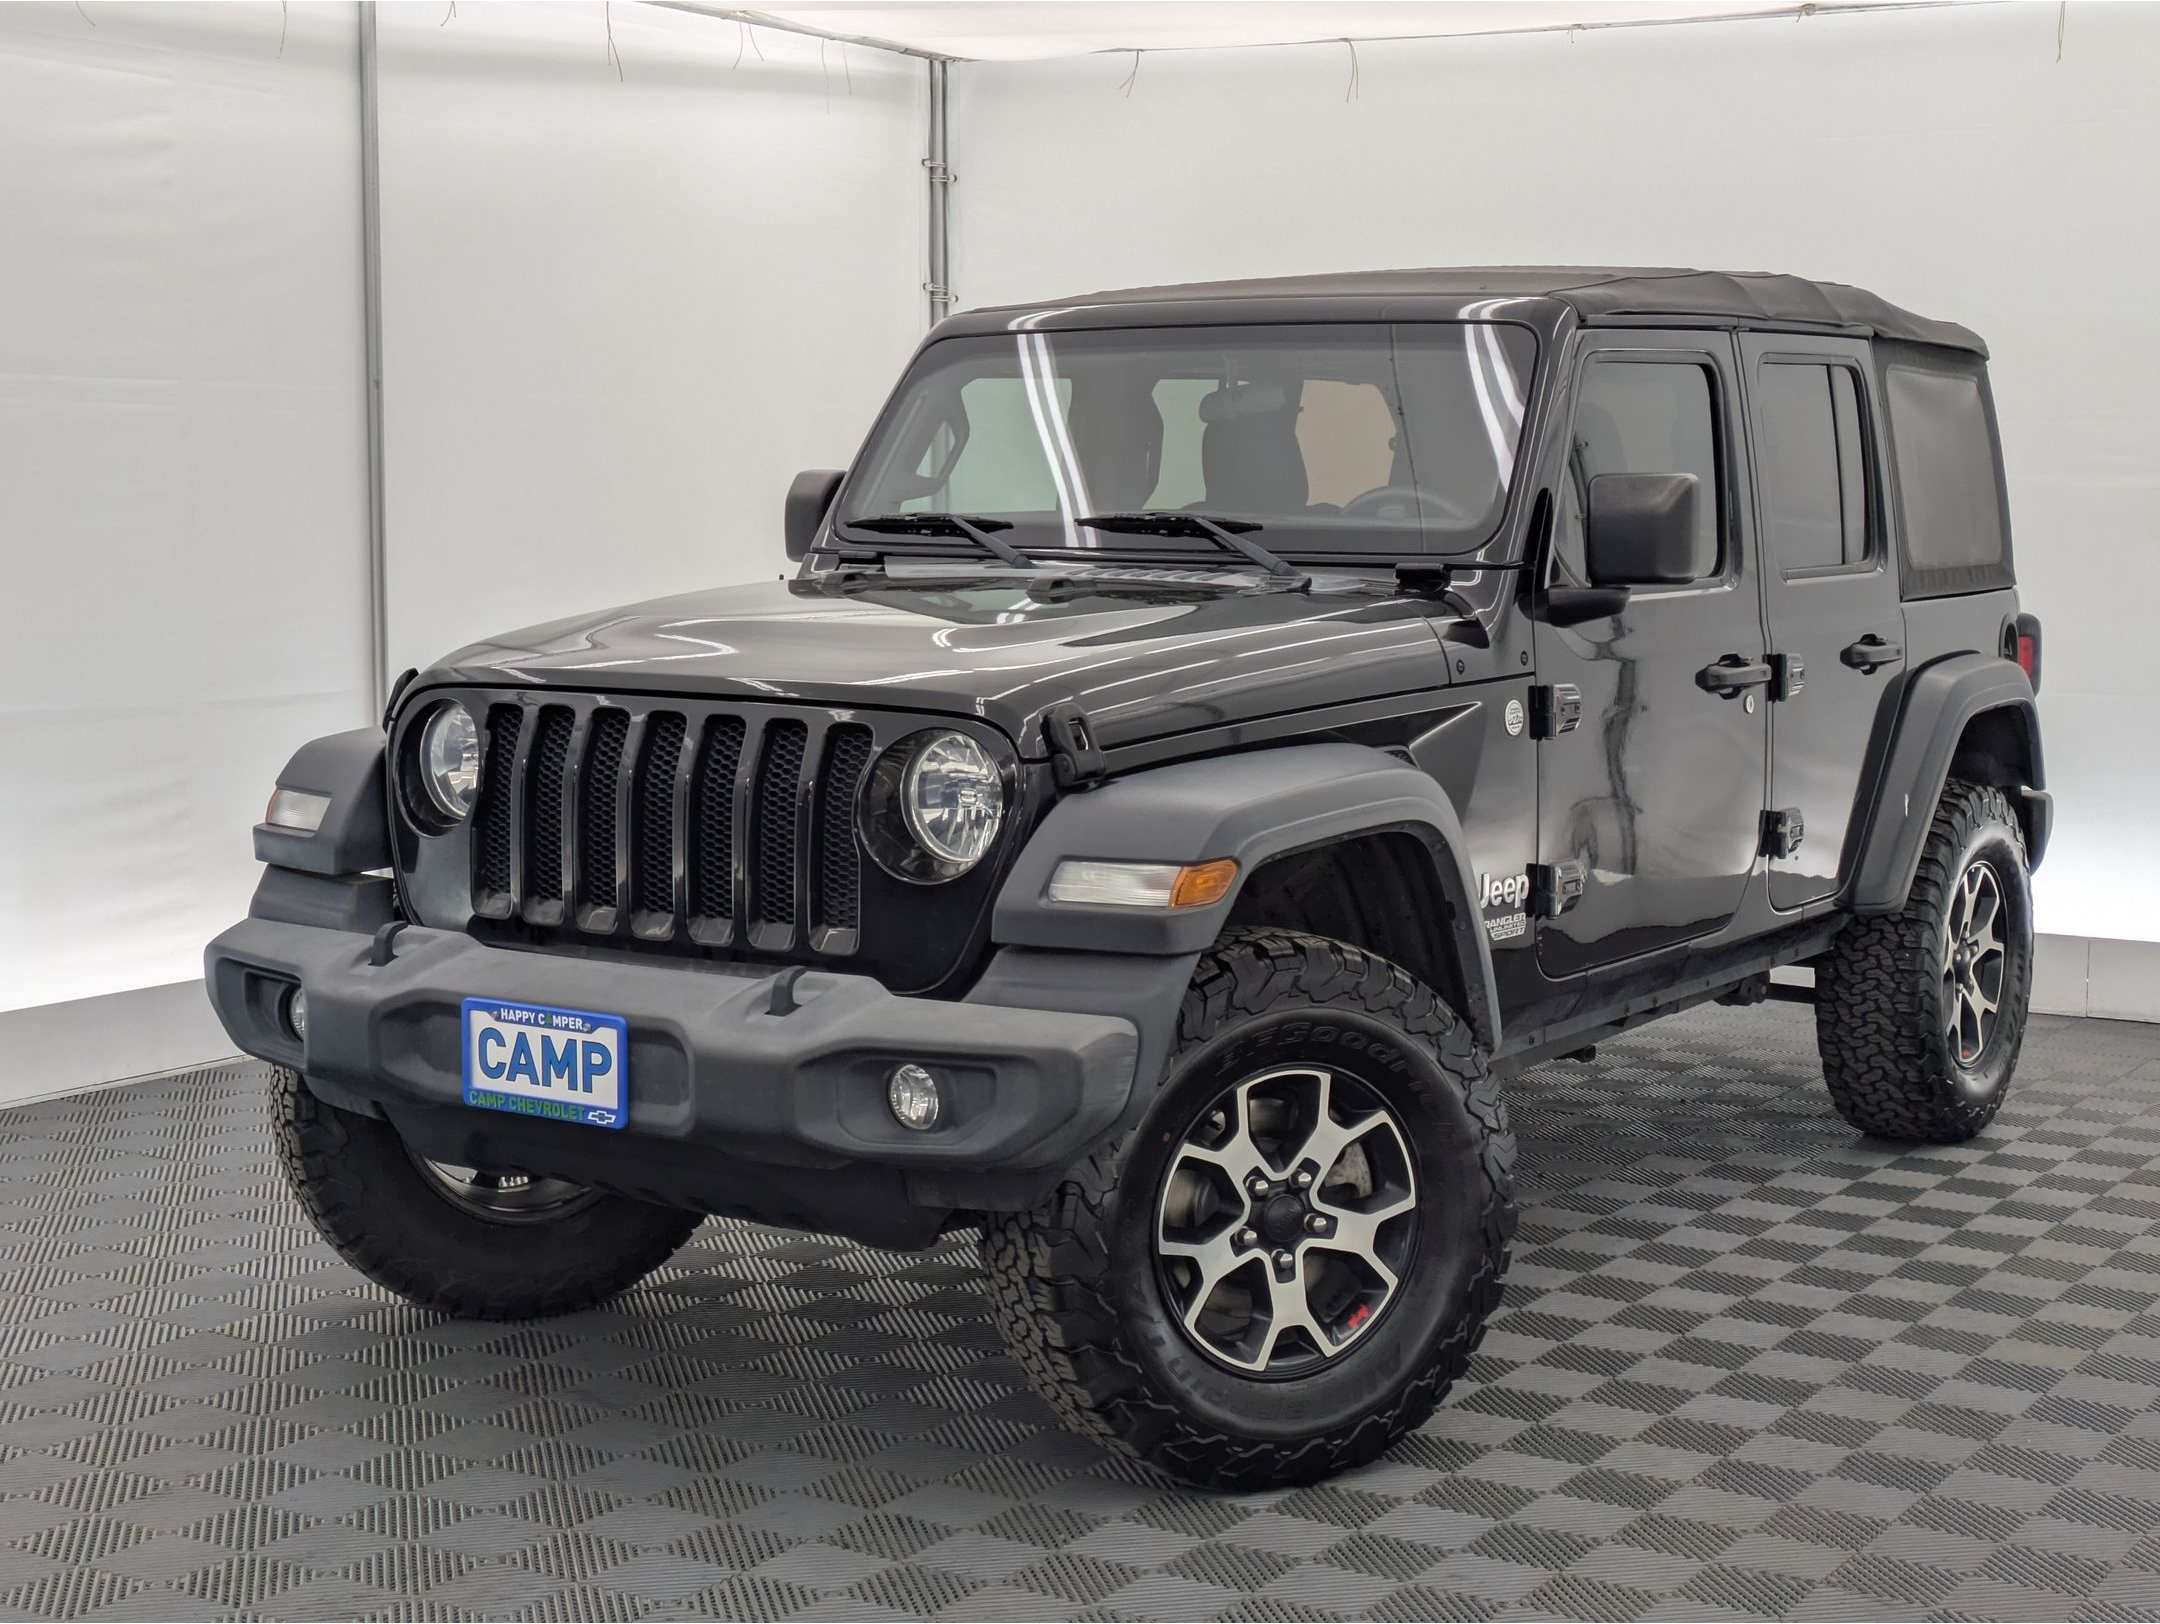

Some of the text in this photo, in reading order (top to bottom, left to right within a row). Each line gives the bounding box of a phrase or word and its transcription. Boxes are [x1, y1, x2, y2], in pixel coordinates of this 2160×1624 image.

[1480, 873, 1530, 909] Jeep
[1484, 912, 1526, 929] RANGLER
[500, 1007, 536, 1025] HAPPY
[478, 1026, 613, 1093] CAMP
[468, 1090, 585, 1121] CAMP CHEVROLET
